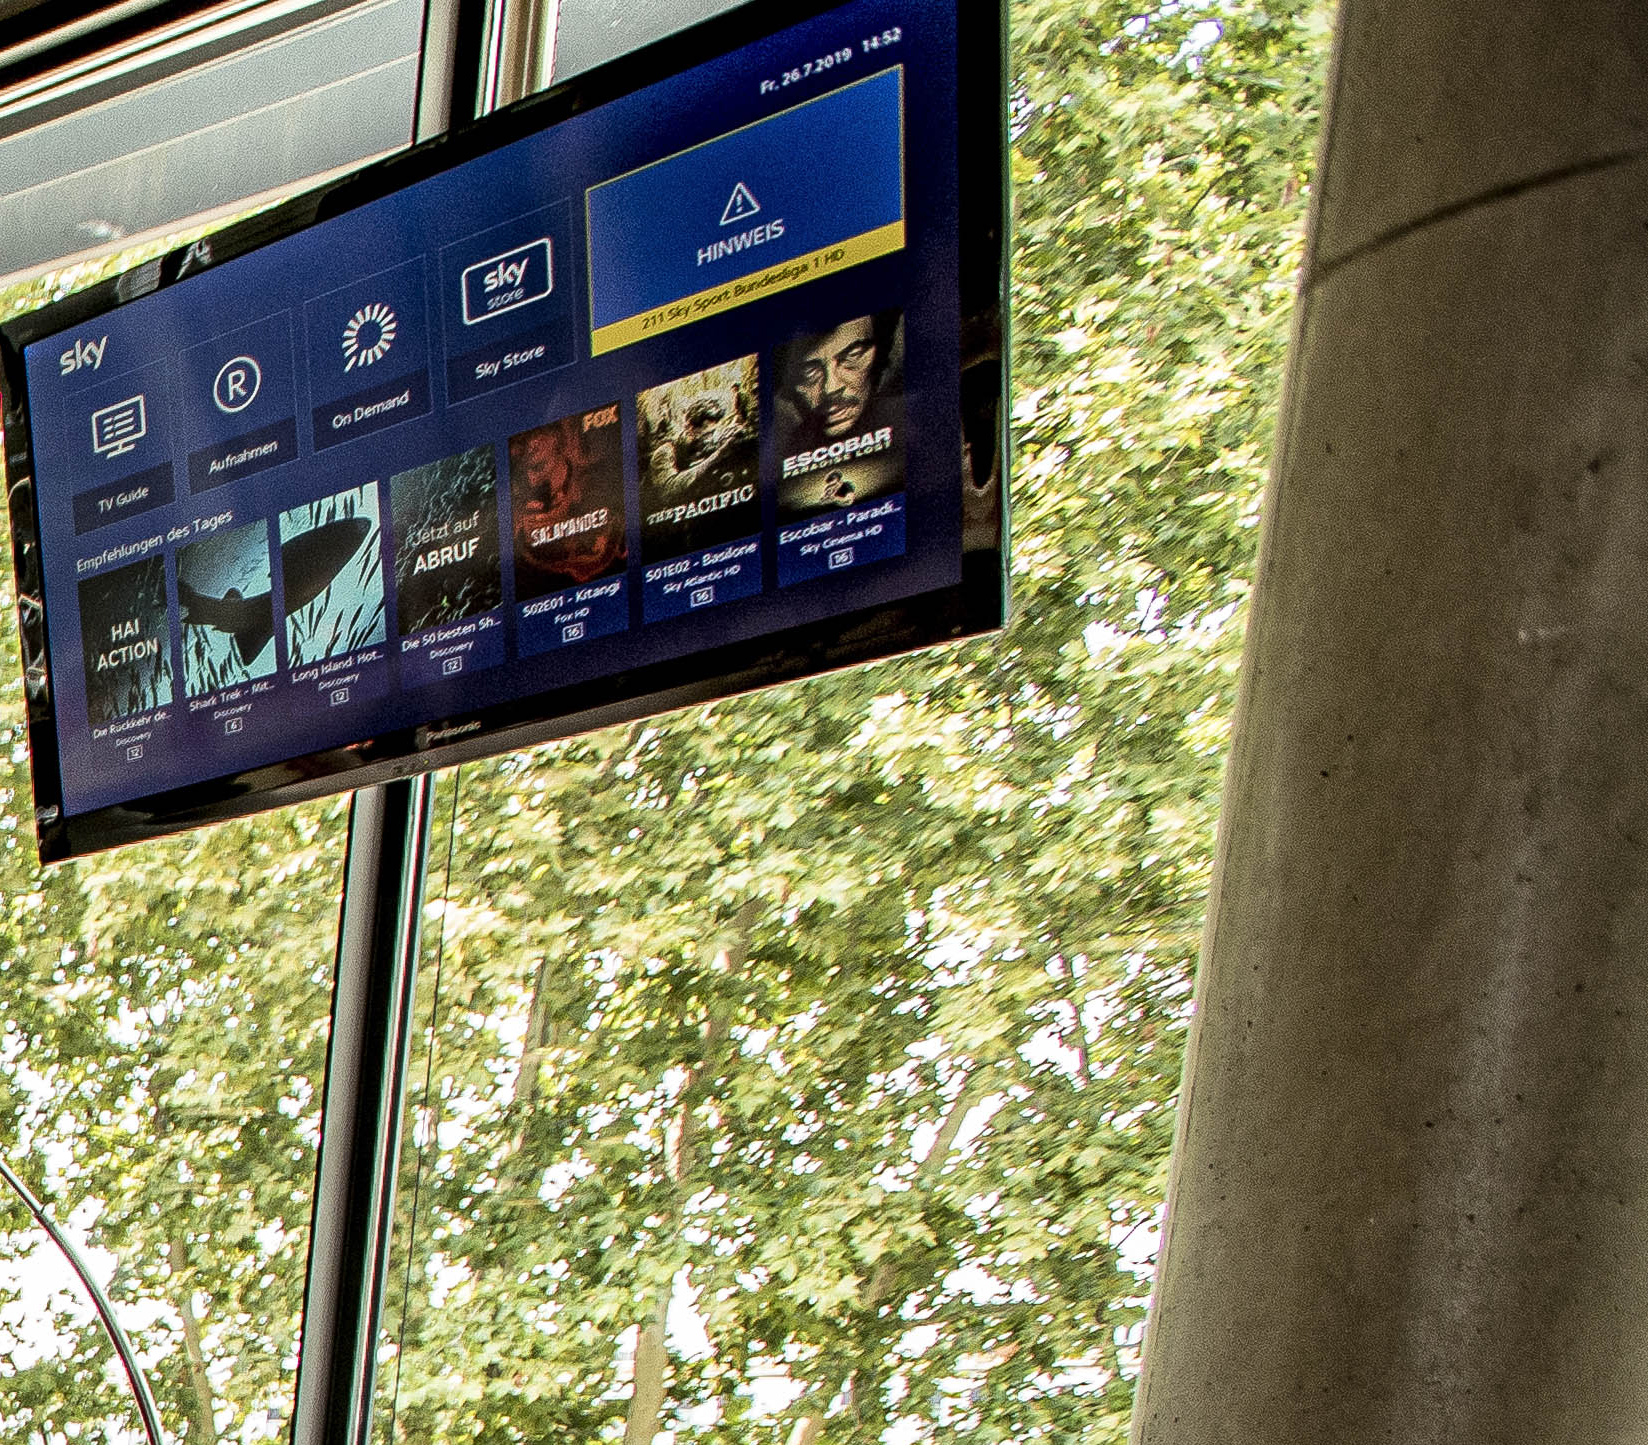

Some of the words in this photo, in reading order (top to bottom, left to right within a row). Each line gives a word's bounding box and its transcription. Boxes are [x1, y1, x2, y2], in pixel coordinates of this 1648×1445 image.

[782, 47, 852, 87] 26.7.2019
[696, 218, 785, 267] HINWEIS
[483, 257, 530, 293] sky
[641, 308, 665, 331] 211
[667, 300, 690, 322] Sky
[692, 288, 731, 313] Sport
[733, 260, 809, 297] Bundesliga
[824, 248, 845, 266] HD
[487, 287, 524, 311] store
[59, 336, 108, 376] sky
[474, 359, 500, 380] Sky
[503, 345, 545, 370] Store
[332, 413, 352, 429] On
[355, 388, 410, 420] Demand
[582, 404, 619, 433] FOX
[208, 440, 279, 476] Aufnahmen
[782, 426, 893, 473] ESCOBAR
[97, 497, 114, 514] TV
[116, 485, 150, 507] Guide
[672, 484, 756, 524] PACIFIC
[454, 510, 480, 533] auf
[530, 507, 609, 548] SALAMANDER
[779, 519, 835, 545] Escobar
[76, 535, 163, 573] Empfehlungen
[166, 524, 191, 543] des
[192, 509, 234, 536] Tages
[413, 536, 481, 577] ABRUF
[645, 560, 690, 583] S01E02
[522, 594, 564, 618] S02E01
[111, 618, 140, 642] HAI
[97, 637, 159, 672] ACTION
[291, 666, 319, 684] Long
